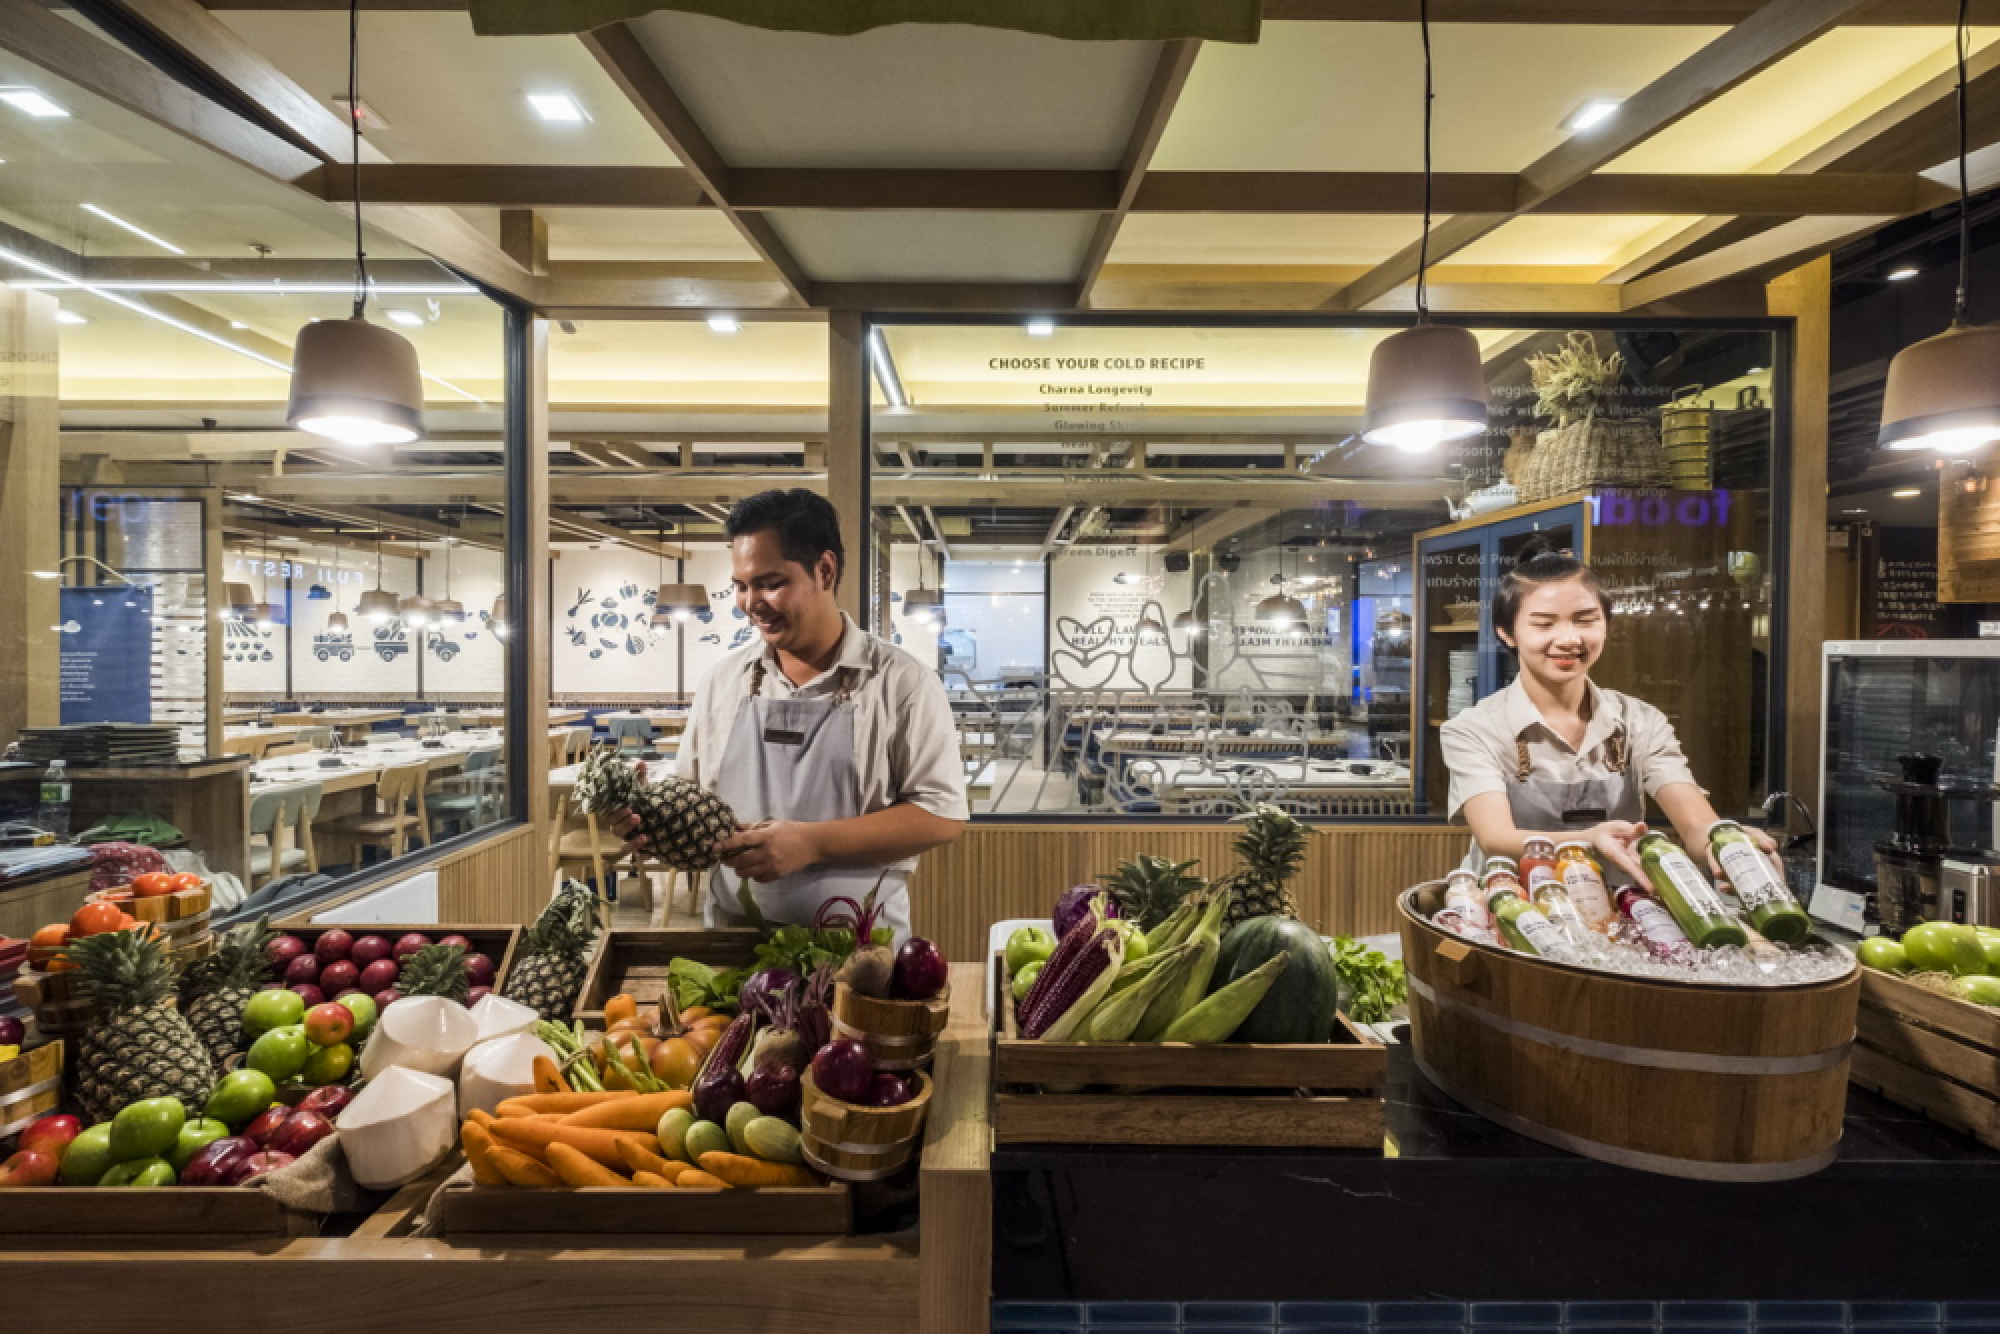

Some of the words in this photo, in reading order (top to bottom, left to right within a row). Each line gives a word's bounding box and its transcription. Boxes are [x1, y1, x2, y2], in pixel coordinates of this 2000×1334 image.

[989, 357, 1050, 370] CHOOSE
[1056, 357, 1099, 370] YOUR
[1104, 357, 1145, 370] COLD
[1150, 357, 1205, 370] RECIPE
[1039, 383, 1085, 395] Charna
[1088, 383, 1153, 396] Longevity
[1457, 554, 1487, 565] Cold
